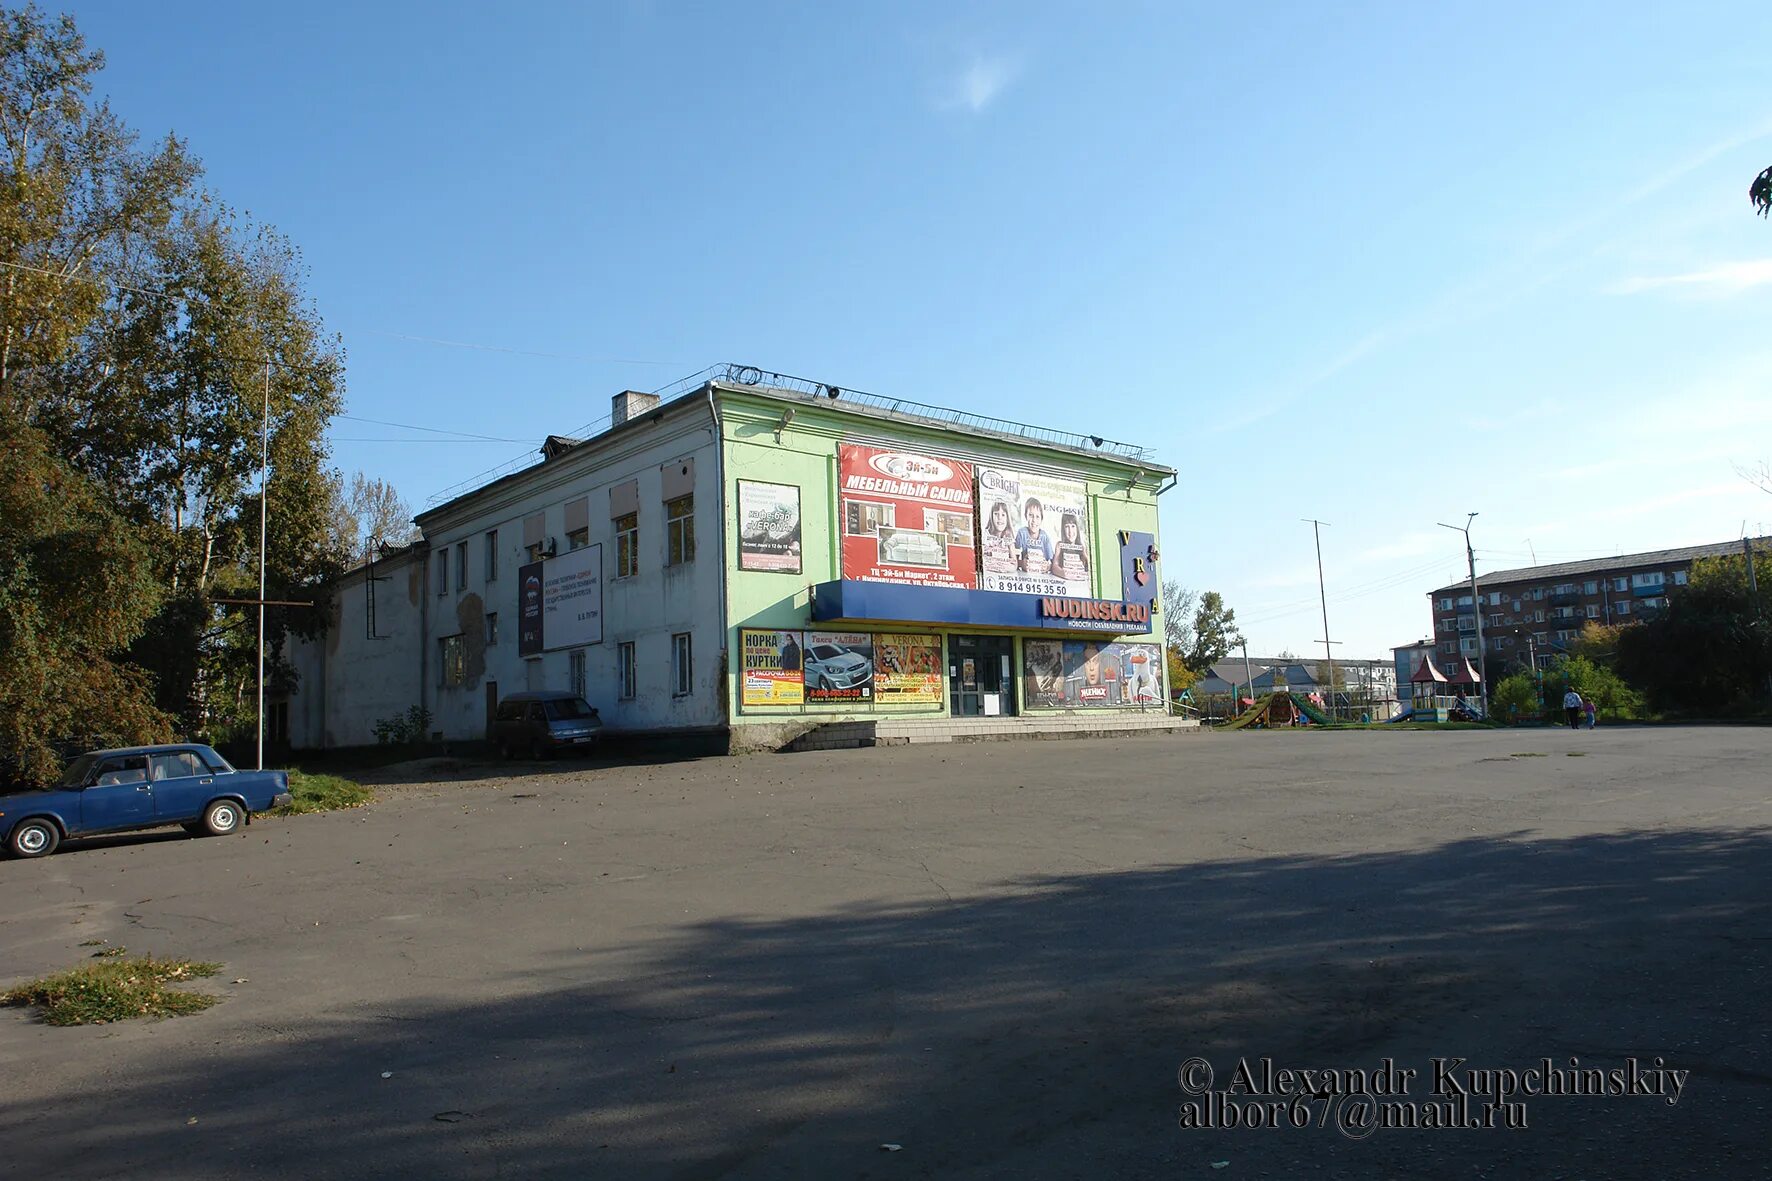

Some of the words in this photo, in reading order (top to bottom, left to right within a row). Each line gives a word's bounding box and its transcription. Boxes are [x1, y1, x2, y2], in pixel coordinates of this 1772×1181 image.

[906, 460, 939, 476] Эй-Би
[846, 474, 928, 498] МЕБЕЛЬНЫЙ
[930, 486, 970, 504] САЛОН
[748, 509, 790, 521] кафе-бар
[1044, 504, 1084, 516] ENGLISH
[870, 568, 880, 576] ТЦ
[999, 582, 1004, 590] 8
[1007, 582, 1023, 591] 914
[1026, 584, 1041, 593] 915
[1044, 586, 1054, 594] 35
[1056, 586, 1066, 595] 50
[1042, 598, 1148, 622] NUDINSK.RU
[746, 634, 778, 647] НОРКА
[892, 636, 924, 645] VERONA
[746, 655, 783, 667] КУРТКИ
[1080, 688, 1106, 696] ЖЕНИХ
